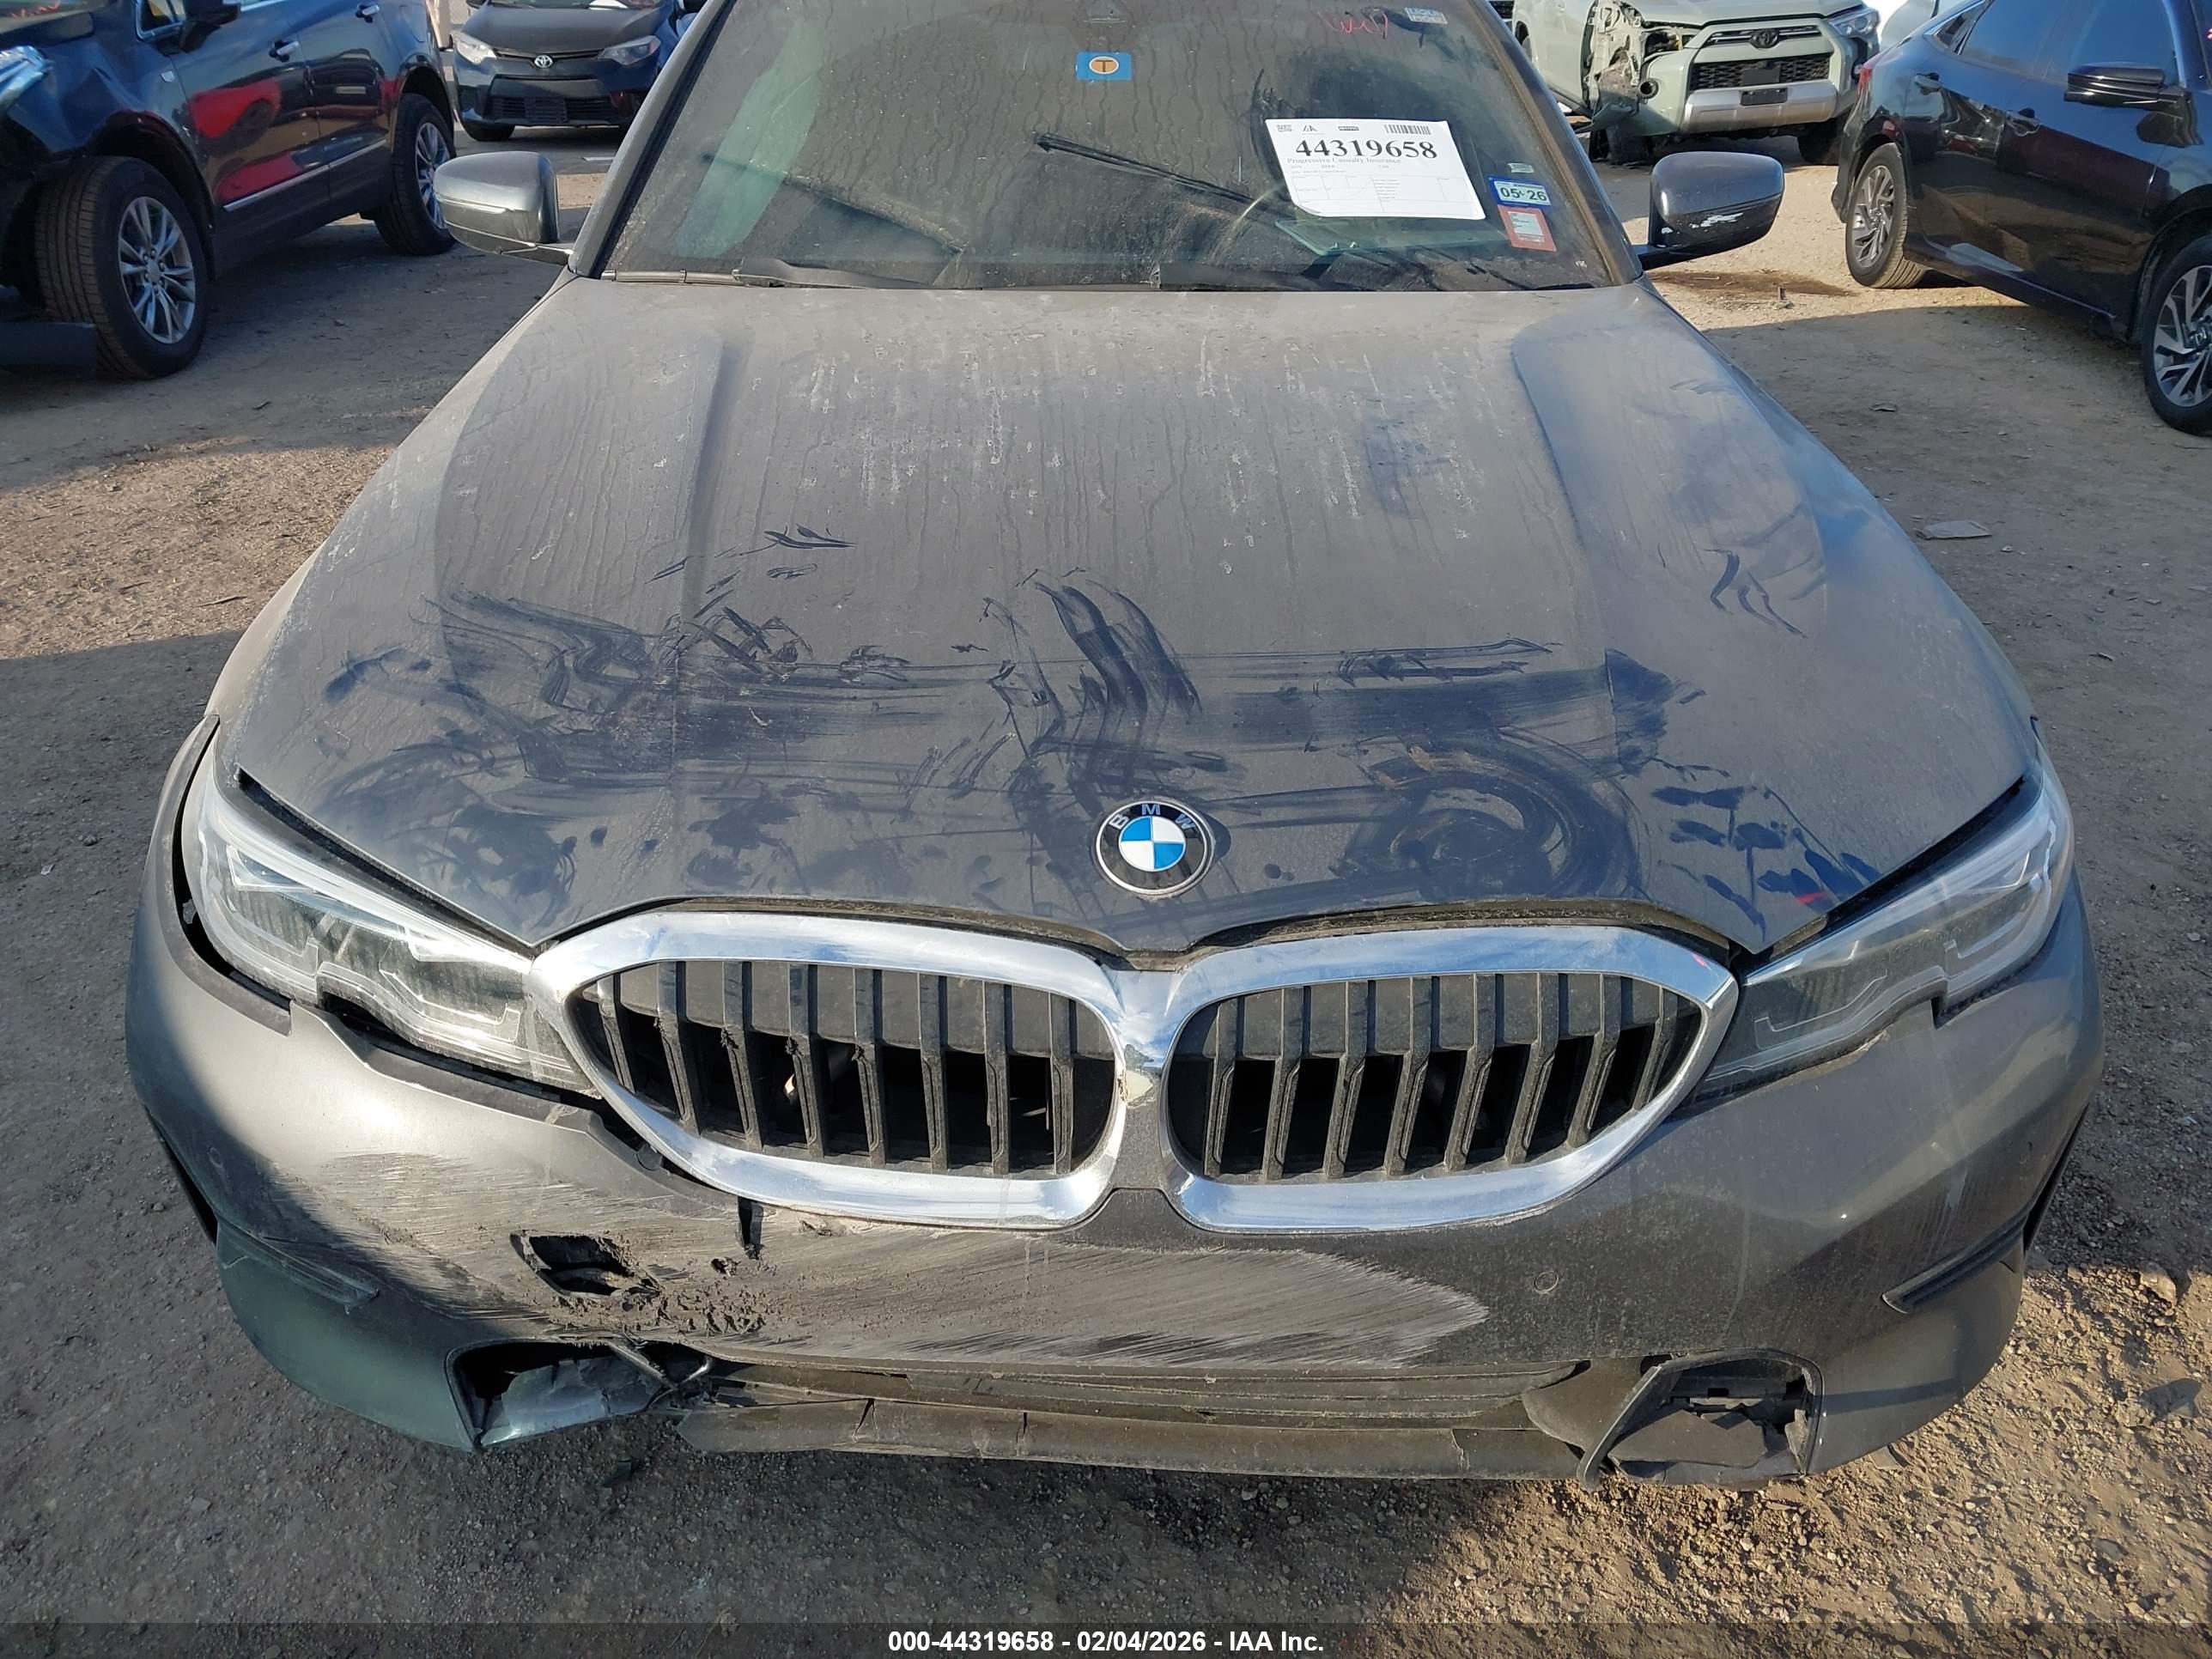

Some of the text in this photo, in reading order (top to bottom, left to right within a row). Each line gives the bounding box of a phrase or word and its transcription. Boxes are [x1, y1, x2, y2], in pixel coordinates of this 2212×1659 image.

[1296, 139, 1437, 159] 44319658
[1500, 187, 1547, 202] 05 26
[1108, 803, 1196, 830] BMW
